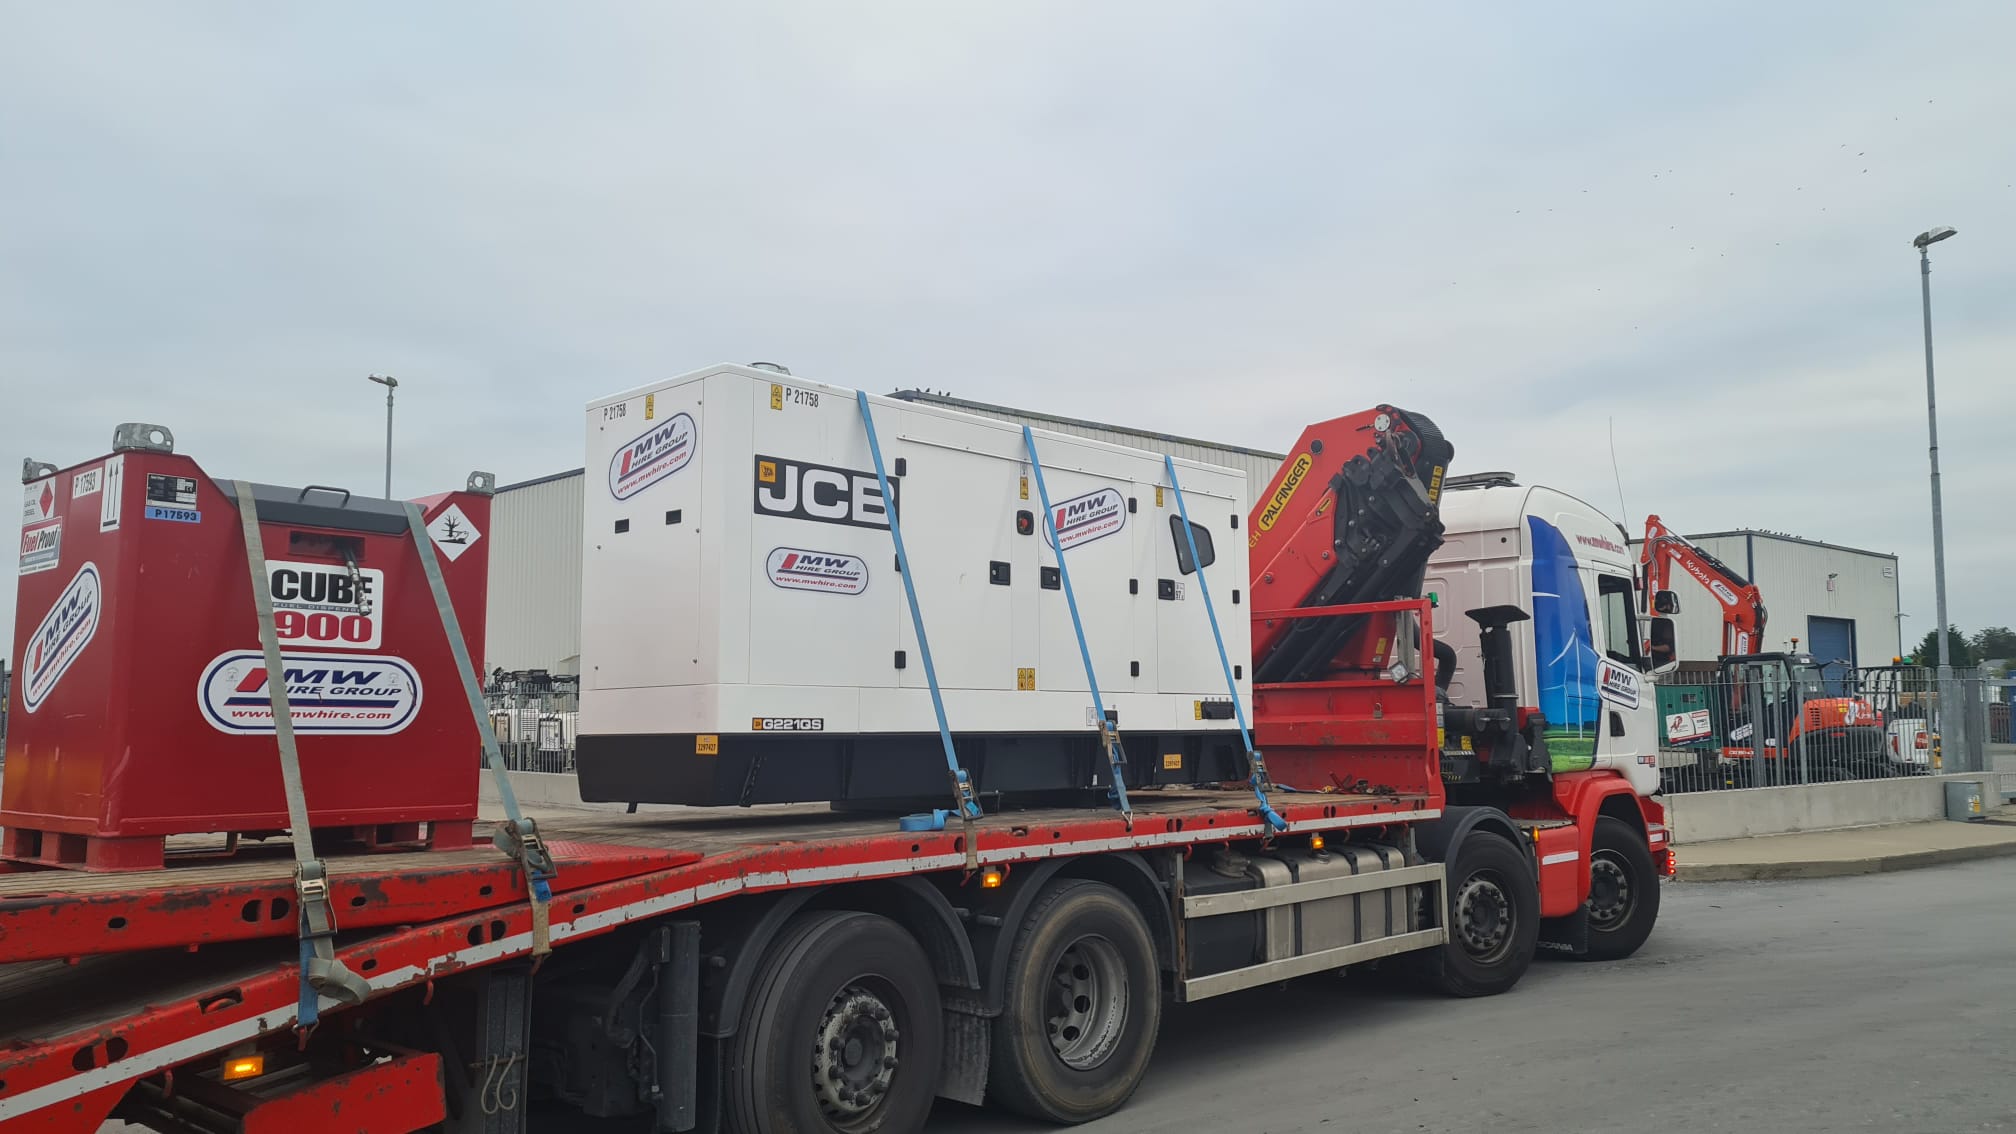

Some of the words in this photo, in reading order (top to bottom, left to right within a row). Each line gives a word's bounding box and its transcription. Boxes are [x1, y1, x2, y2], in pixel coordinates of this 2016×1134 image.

[786, 387, 792, 402] P
[794, 389, 819, 408] 21758
[604, 408, 608, 421] P
[610, 403, 627, 420] 21758
[631, 451, 653, 469] HIRE
[655, 431, 688, 454] GROUP
[634, 422, 676, 458] MW
[75, 477, 80, 497] P
[80, 472, 96, 494] 17593
[618, 451, 687, 494] www.mwhire.com
[758, 464, 896, 525] JCB
[1261, 458, 1310, 527] PALFINGER
[155, 508, 196, 521] P17593
[1066, 514, 1088, 526] HIRE
[1089, 504, 1118, 518] GROUP
[1068, 495, 1106, 517] MW
[22, 531, 40, 553] Fuel
[38, 526, 58, 550] Proof
[800, 555, 850, 568] MW
[1686, 560, 1710, 584] Kubota
[271, 568, 373, 606] CUBE
[776, 576, 856, 589] www.mwhire.com
[43, 631, 60, 661] HIRE
[62, 590, 92, 632] GROUP
[45, 586, 82, 646] MW
[274, 610, 372, 642] 900
[32, 618, 91, 697] www.mwhire.com
[284, 668, 382, 685] MW
[1611, 670, 1632, 686] MW
[286, 686, 324, 694] IRE
[330, 687, 402, 697] GROUP
[232, 710, 392, 720] wwwmwhire.com
[762, 719, 822, 730] G221QS
